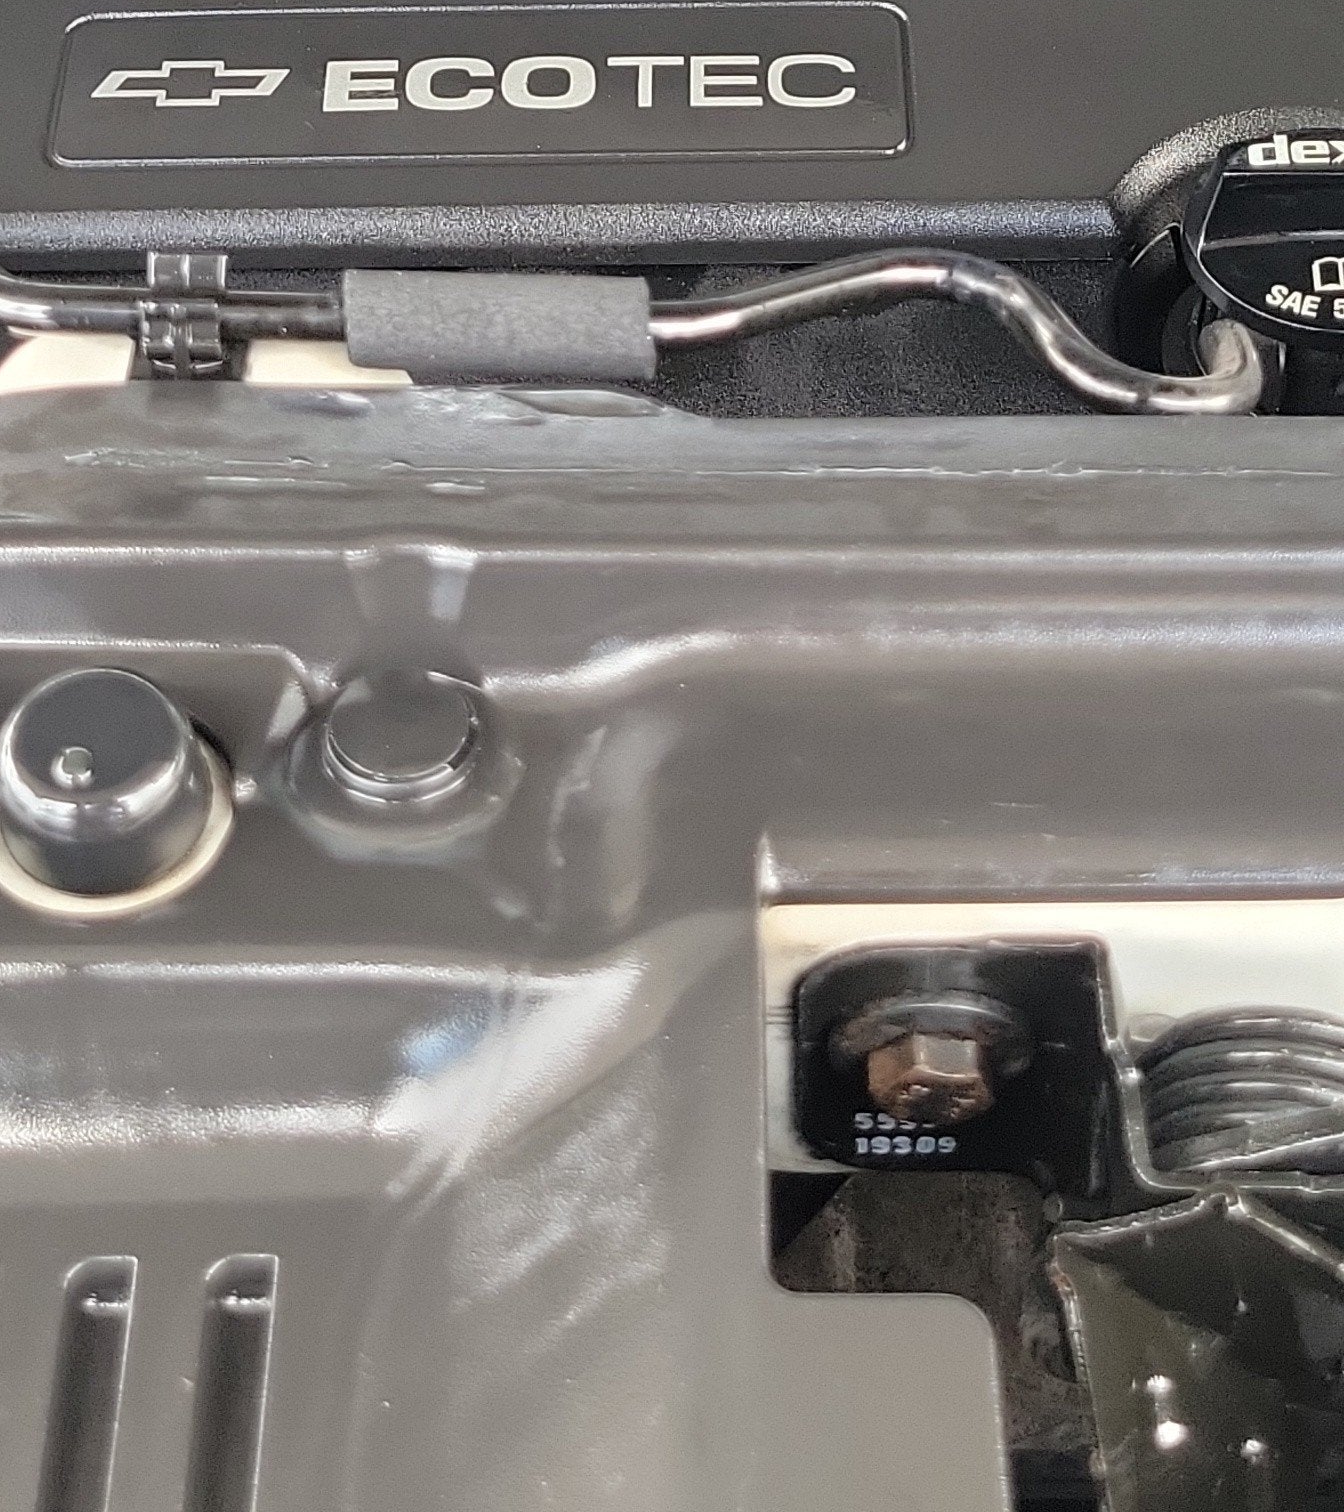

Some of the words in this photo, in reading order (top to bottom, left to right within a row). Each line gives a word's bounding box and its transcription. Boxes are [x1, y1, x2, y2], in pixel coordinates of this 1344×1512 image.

[322, 55, 856, 112] ECOTEC
[1265, 284, 1322, 319] SAE
[854, 1135, 957, 1155] 19309
